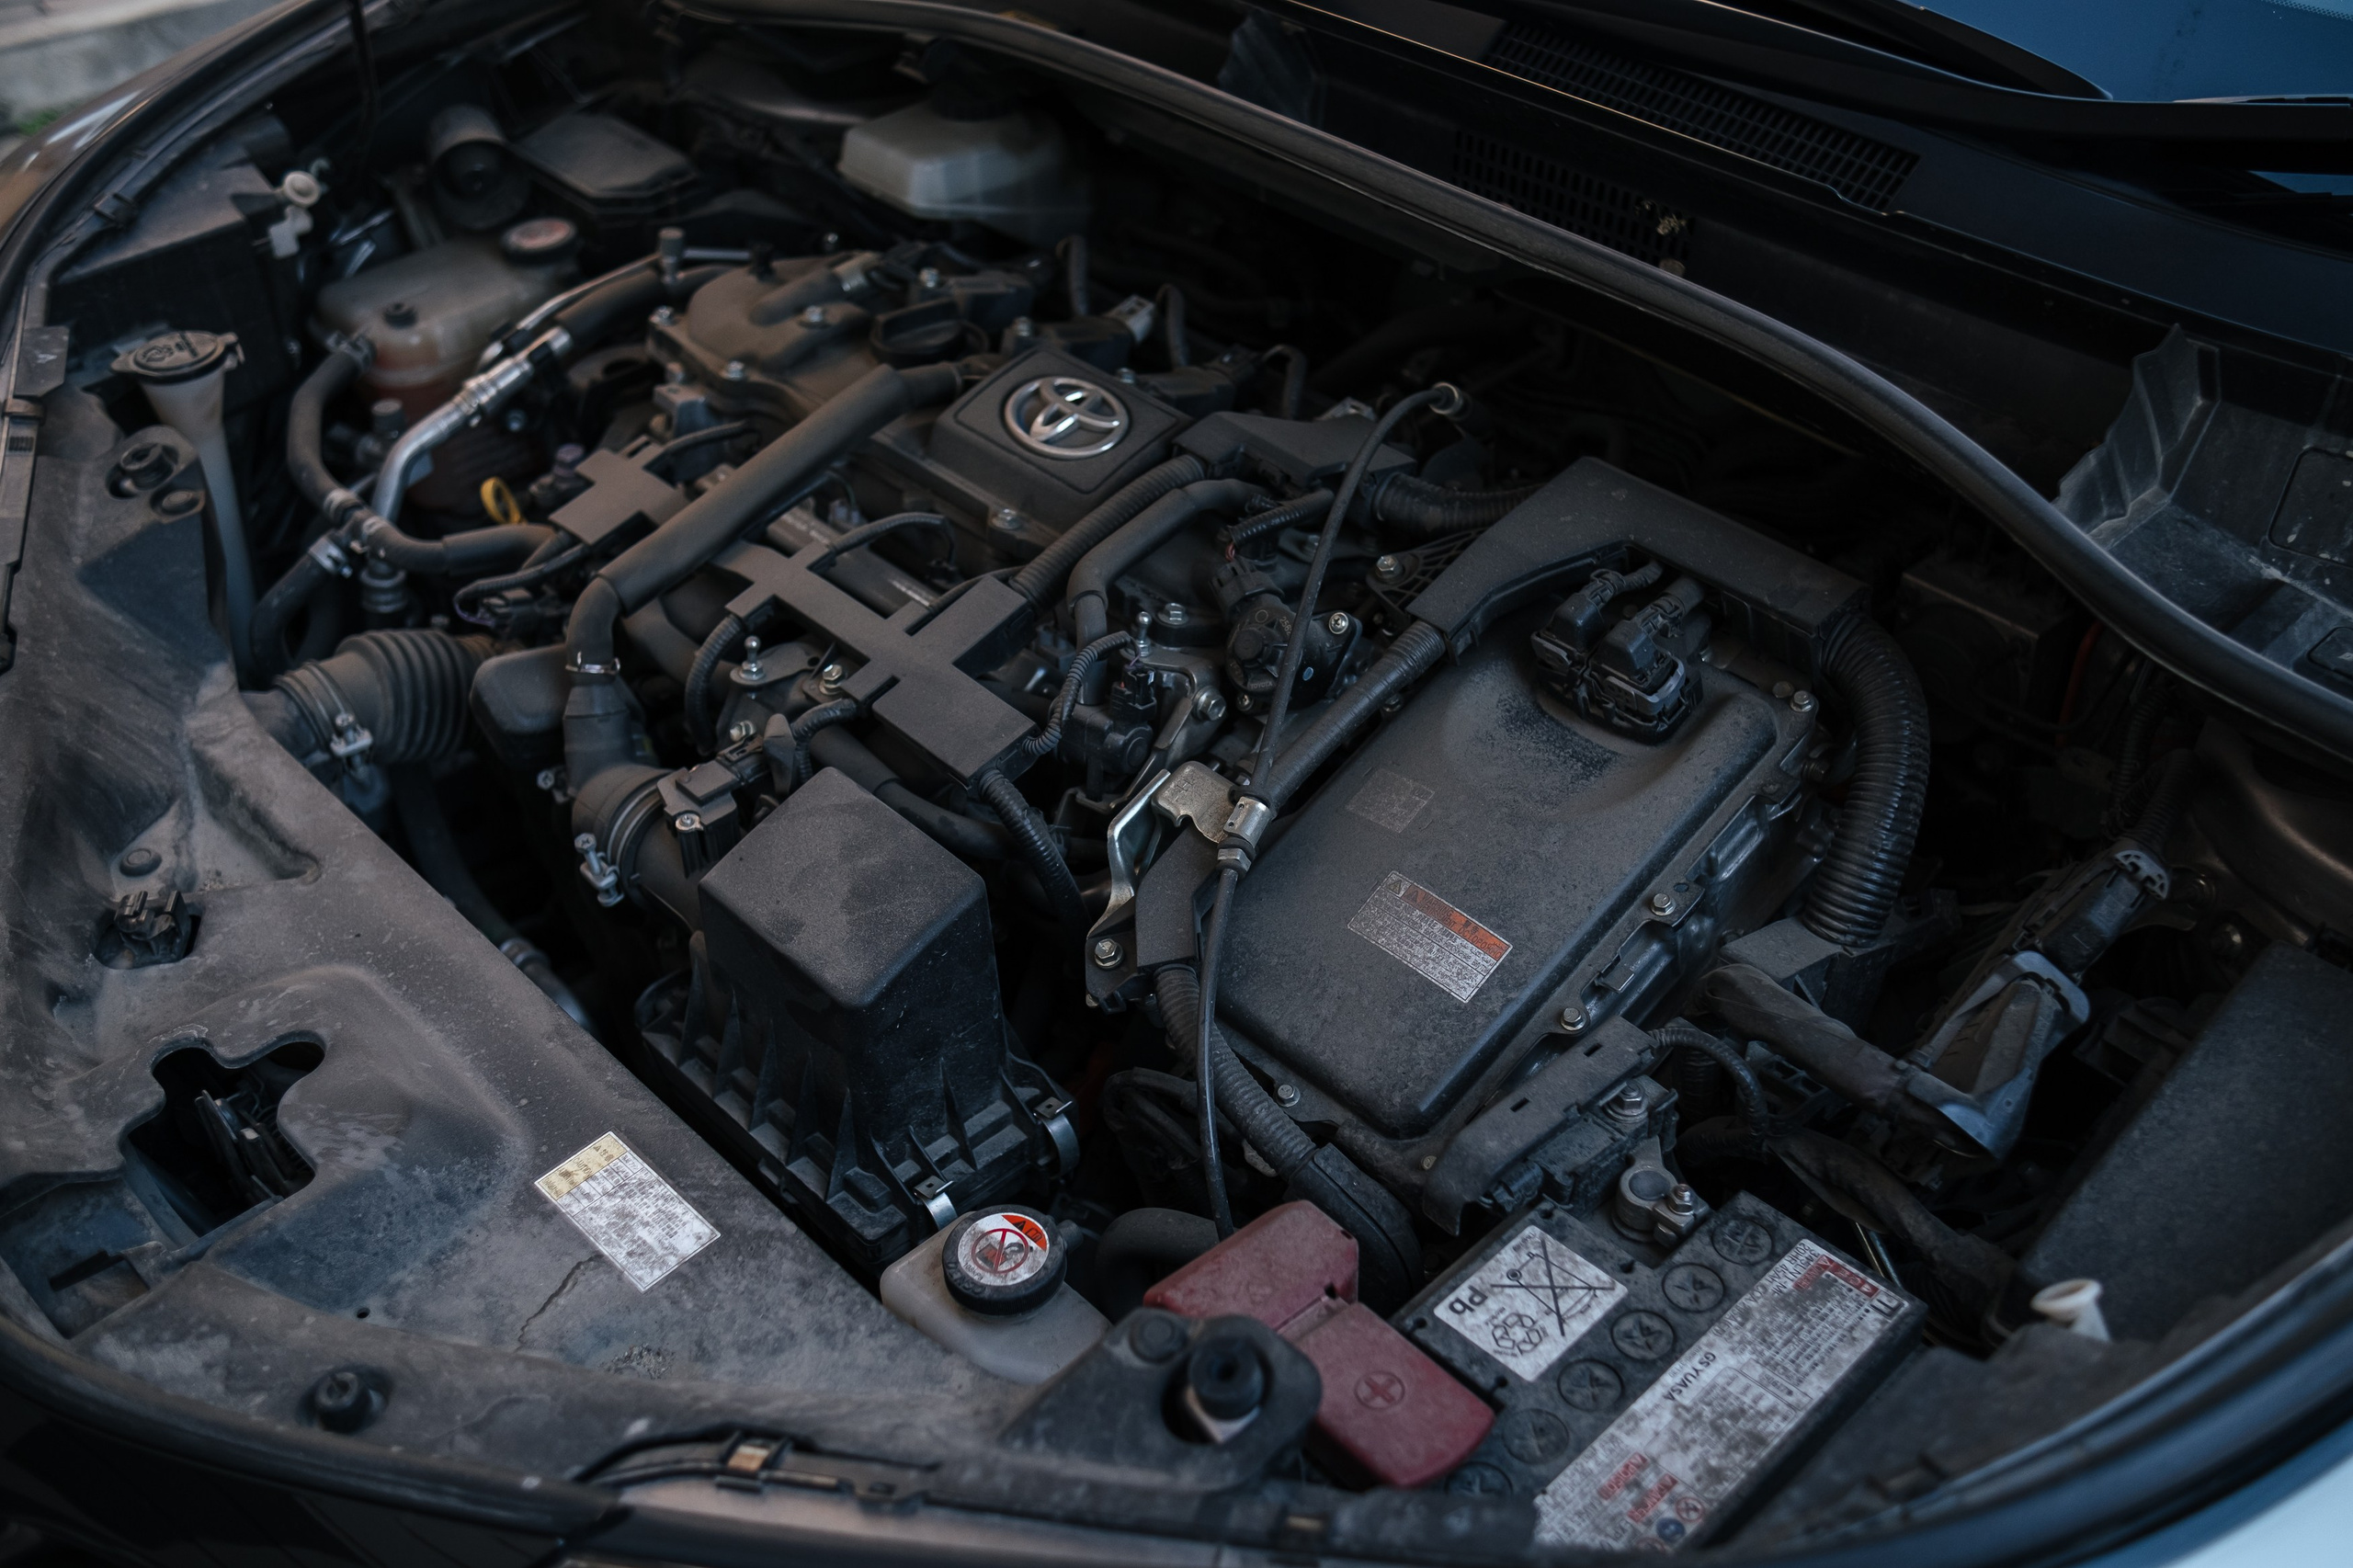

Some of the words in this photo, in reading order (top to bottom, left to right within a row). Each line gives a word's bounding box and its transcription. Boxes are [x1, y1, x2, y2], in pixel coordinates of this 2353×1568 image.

[1784, 1240, 1810, 1267] 20HR
[945, 1262, 983, 1296] DENSO
[1448, 1285, 1488, 1314] Pb
[1696, 1348, 1717, 1369] GS
[1661, 1361, 1705, 1405] YUASA
